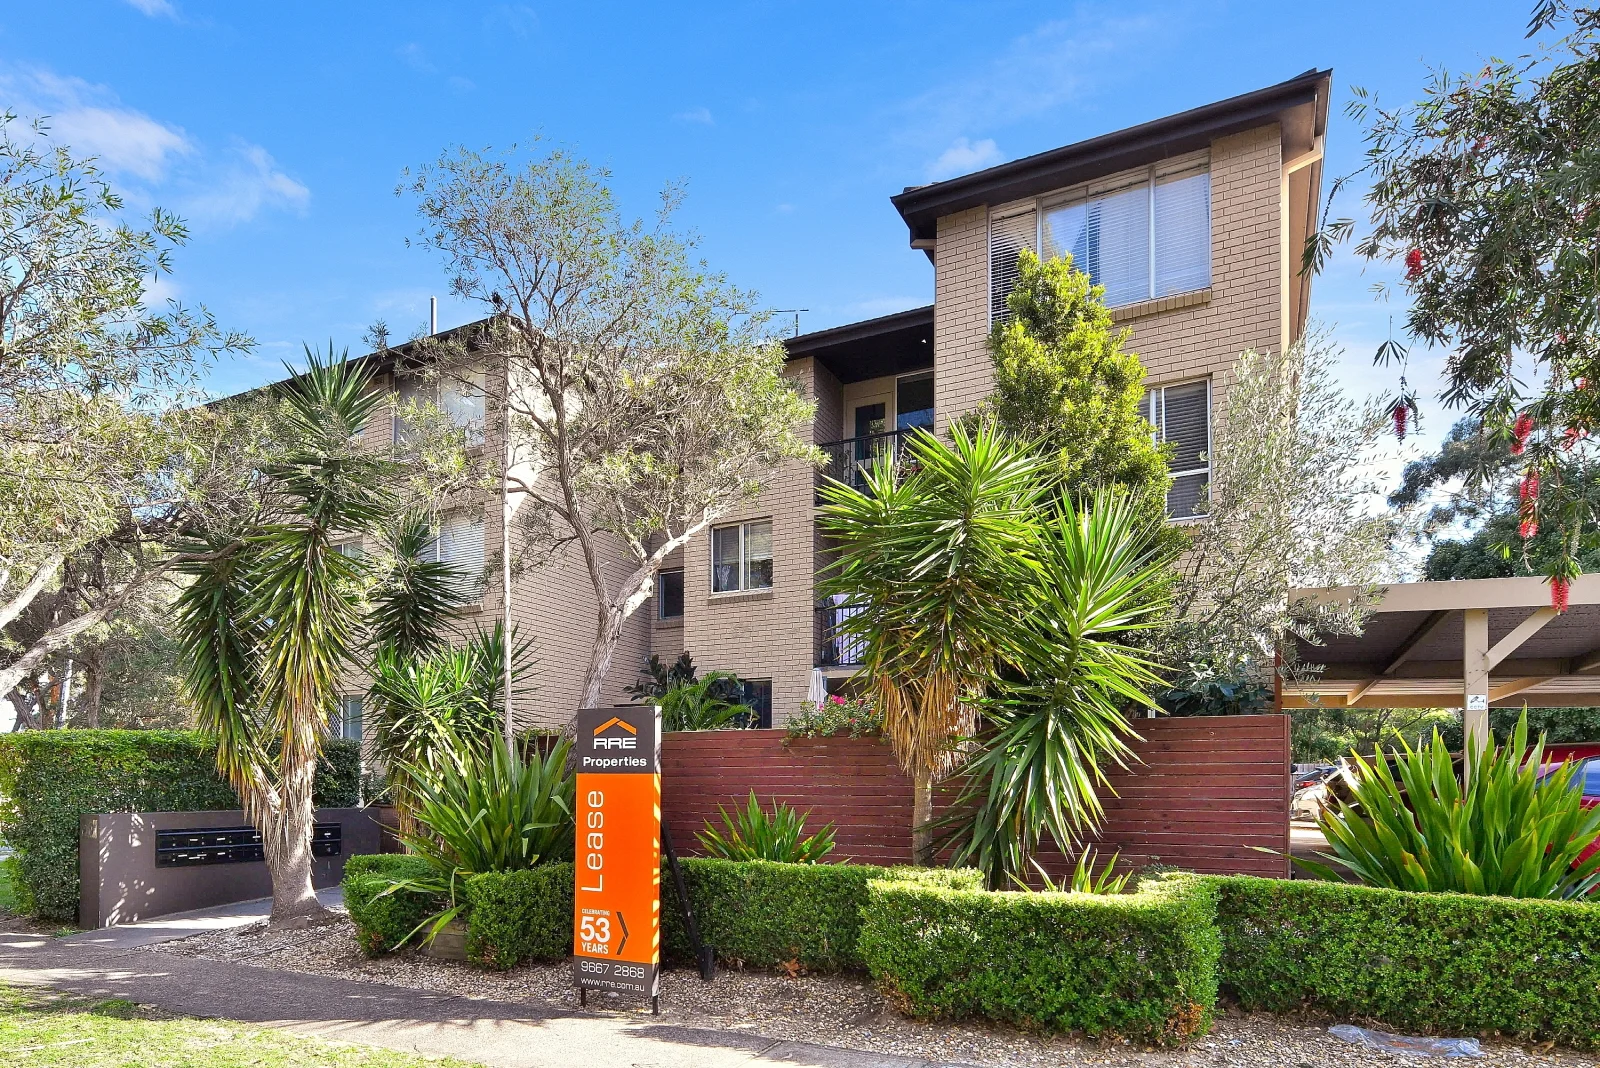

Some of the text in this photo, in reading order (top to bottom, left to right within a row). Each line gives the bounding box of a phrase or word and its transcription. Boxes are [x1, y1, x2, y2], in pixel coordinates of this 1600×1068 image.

[593, 737, 637, 749] RRE
[583, 757, 647, 768] Properties
[580, 790, 604, 892] Lease
[581, 908, 611, 916] CELEBRATING
[579, 915, 611, 943] 53
[581, 941, 609, 955] YEARS
[580, 960, 645, 979] 9667 2868
[580, 977, 645, 992] www.rre.com.au
